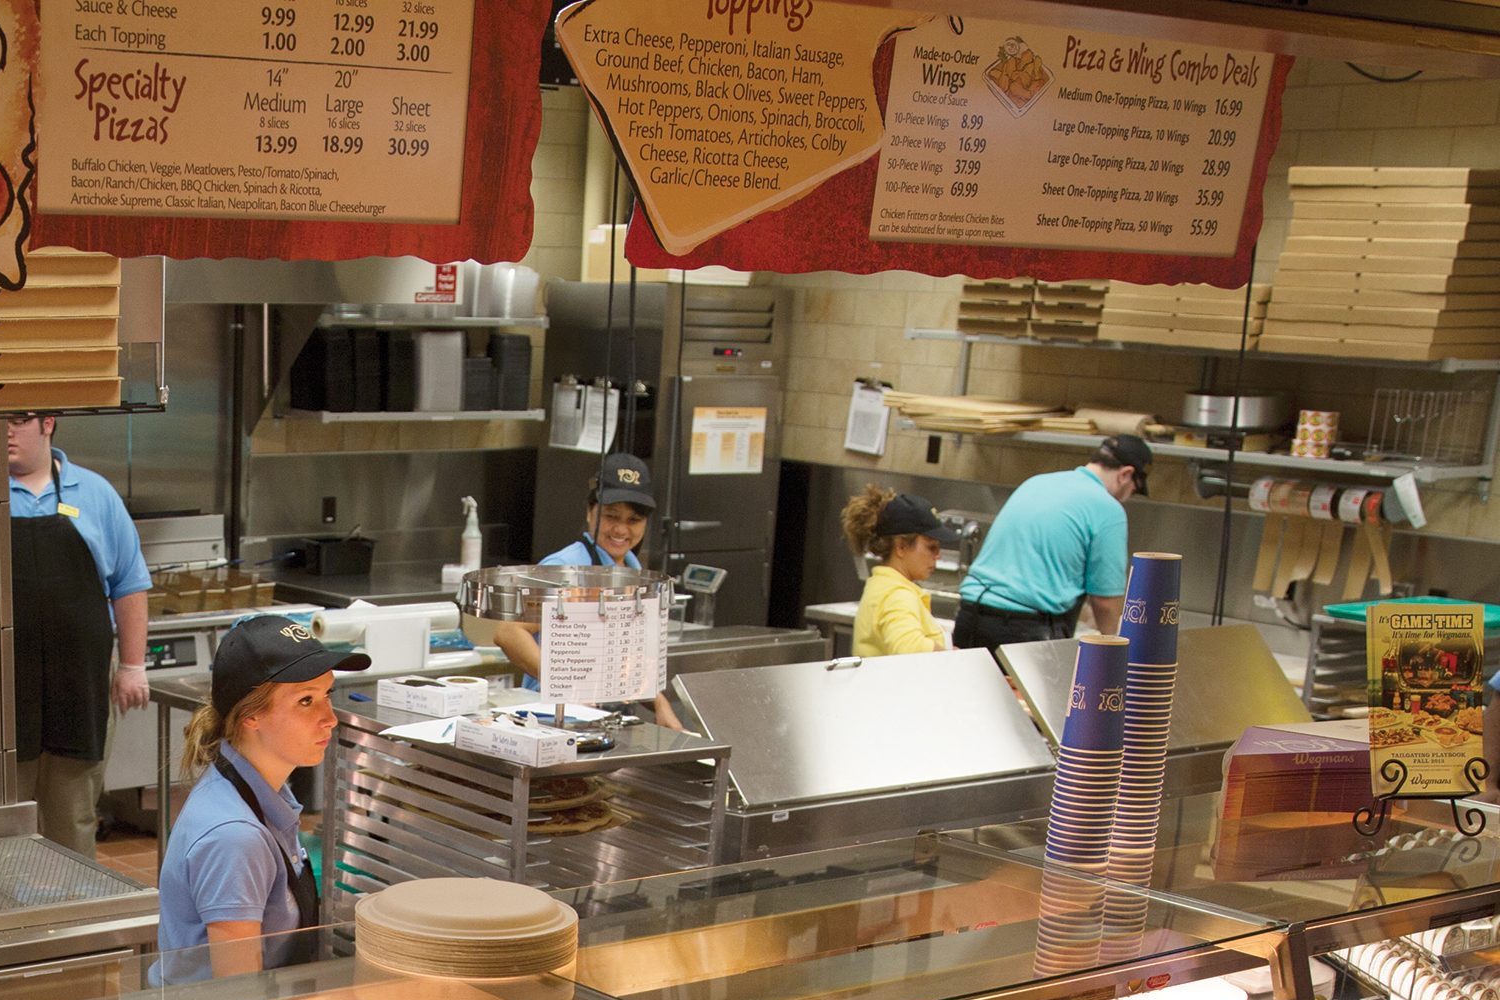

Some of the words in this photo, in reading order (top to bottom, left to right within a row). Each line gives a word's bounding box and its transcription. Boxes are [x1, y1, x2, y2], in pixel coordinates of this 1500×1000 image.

[132, 4, 177, 20] Cheese
[261, 8, 296, 27] 9.99
[334, 14, 374, 34] 12.99
[398, 20, 438, 40] 21.99
[75, 25, 105, 42] Each
[110, 28, 166, 49] Topping
[585, 24, 620, 44] Extra
[625, 28, 675, 50] Cheese,
[680, 33, 749, 58] Pepperoni,
[753, 40, 790, 60] Italian
[794, 44, 845, 68] Sausage,
[913, 46, 979, 65] Made-to-Order
[1063, 35, 1106, 71] Pizza
[1109, 48, 1123, 72] &
[1127, 42, 1167, 84] Wing
[1171, 50, 1218, 86] Combo
[1222, 53, 1260, 88] Deals
[596, 49, 649, 70] Ground
[653, 54, 684, 74] Beef,
[688, 56, 742, 80] Chicken,
[748, 62, 787, 83] Bacon,
[792, 68, 824, 87] Ham,
[75, 59, 186, 111] Specialty
[922, 64, 965, 94] Wings
[244, 92, 306, 115] Medium
[326, 96, 364, 119] Large
[391, 97, 431, 118] Sheet
[1058, 87, 1092, 102] Medium
[1095, 91, 1146, 110] One-Topping
[1149, 96, 1170, 111] Pizza,
[1173, 100, 1181, 109] 10
[1184, 100, 1206, 116] Wings
[1215, 99, 1242, 117] 16.99
[94, 102, 169, 145] Pizzas
[895, 112, 924, 125] 10-Piece
[926, 114, 949, 130] Wings
[961, 114, 983, 130] 8.99
[255, 134, 297, 154] 13.99
[322, 136, 363, 154] 18.99
[388, 138, 429, 157] 30.99
[959, 137, 986, 153] 16.99
[1208, 129, 1236, 148] 20.99
[72, 158, 105, 173] Buffalo
[108, 160, 147, 175] Chicken,
[150, 161, 182, 177] Veggie,
[185, 162, 235, 177] Meatlovers,
[888, 159, 918, 171] 50-Piece
[921, 160, 943, 174] Wings
[954, 160, 980, 175] 37.99
[1202, 160, 1230, 177] 28.99
[181, 179, 201, 194] BBQ
[244, 181, 277, 195] Spinach
[951, 182, 978, 197] 69.99
[72, 194, 118, 206] Artichoke
[329, 201, 386, 216] Cheeseburger
[1196, 190, 1223, 207] 35.99
[1190, 220, 1218, 236] 55.99
[1390, 614, 1433, 629] GAME
[1434, 614, 1473, 629] TIME
[1405, 631, 1421, 639] time
[1437, 631, 1472, 640] Wegmans.
[1292, 752, 1355, 767] Wegmans
[1411, 774, 1451, 789] Wegmans
